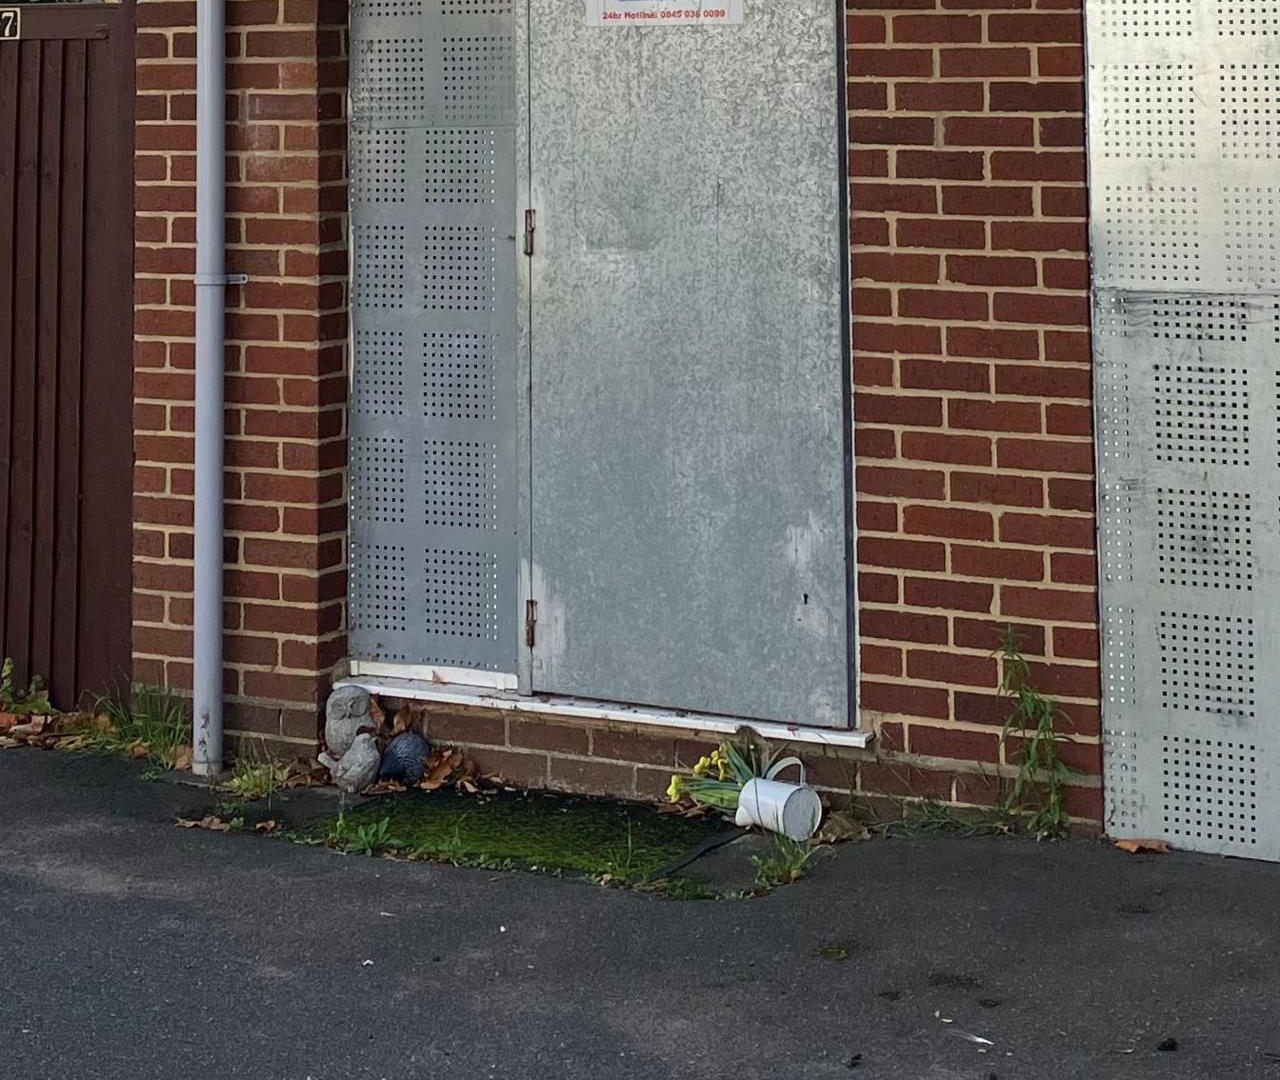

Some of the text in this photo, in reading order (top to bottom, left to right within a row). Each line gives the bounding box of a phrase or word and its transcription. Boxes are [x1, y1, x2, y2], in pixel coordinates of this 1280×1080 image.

[603, 11, 621, 20] 24hr
[624, 10, 657, 19] Hotline:
[660, 10, 683, 18] 0845
[703, 9, 725, 18] 0099
[1, 11, 14, 37] 7
